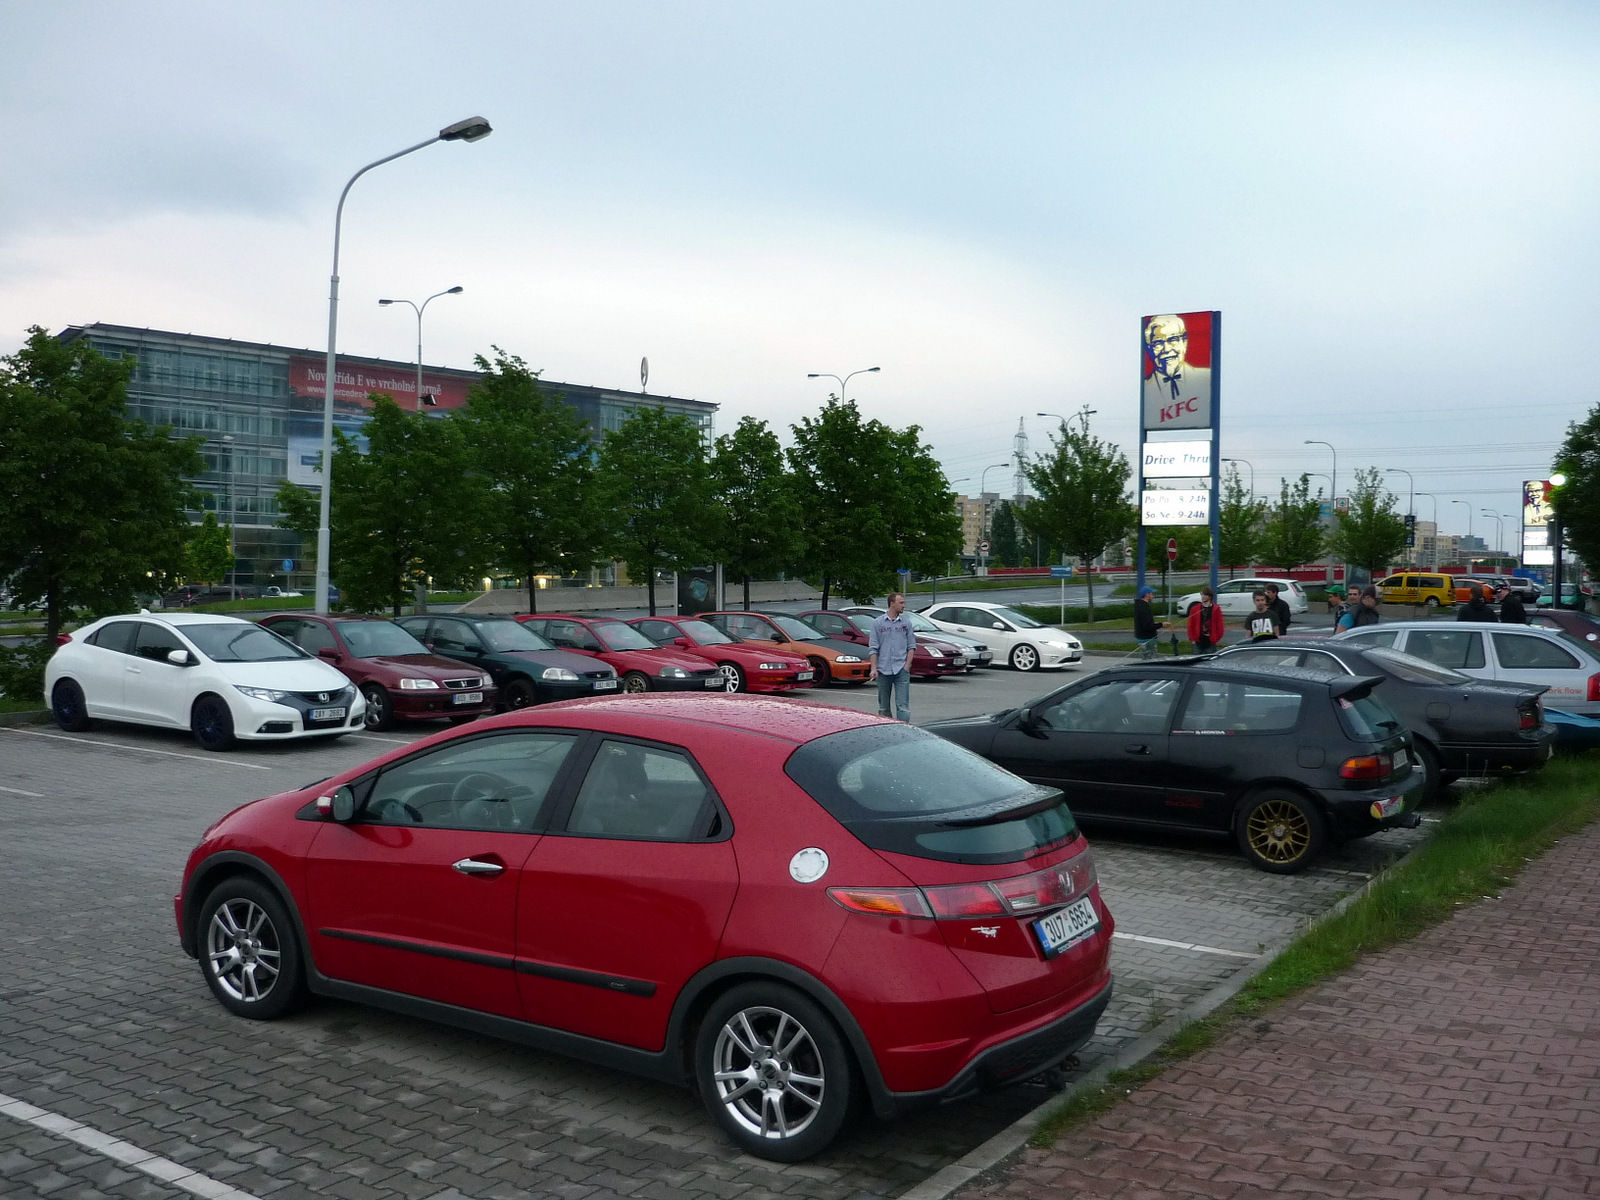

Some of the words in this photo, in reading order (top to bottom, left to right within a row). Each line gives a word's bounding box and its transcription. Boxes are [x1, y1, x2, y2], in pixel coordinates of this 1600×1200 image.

[307, 368, 327, 382] Nov
[357, 374, 364, 386] E
[365, 378, 377, 388] ve
[378, 378, 416, 393] vrcholné
[420, 384, 442, 396] ormě
[1160, 396, 1198, 423] KFC
[1145, 454, 1176, 466] Drive
[1183, 453, 1209, 464] Thru
[1045, 915, 1066, 943] 3U7
[1068, 902, 1094, 930] 6654
